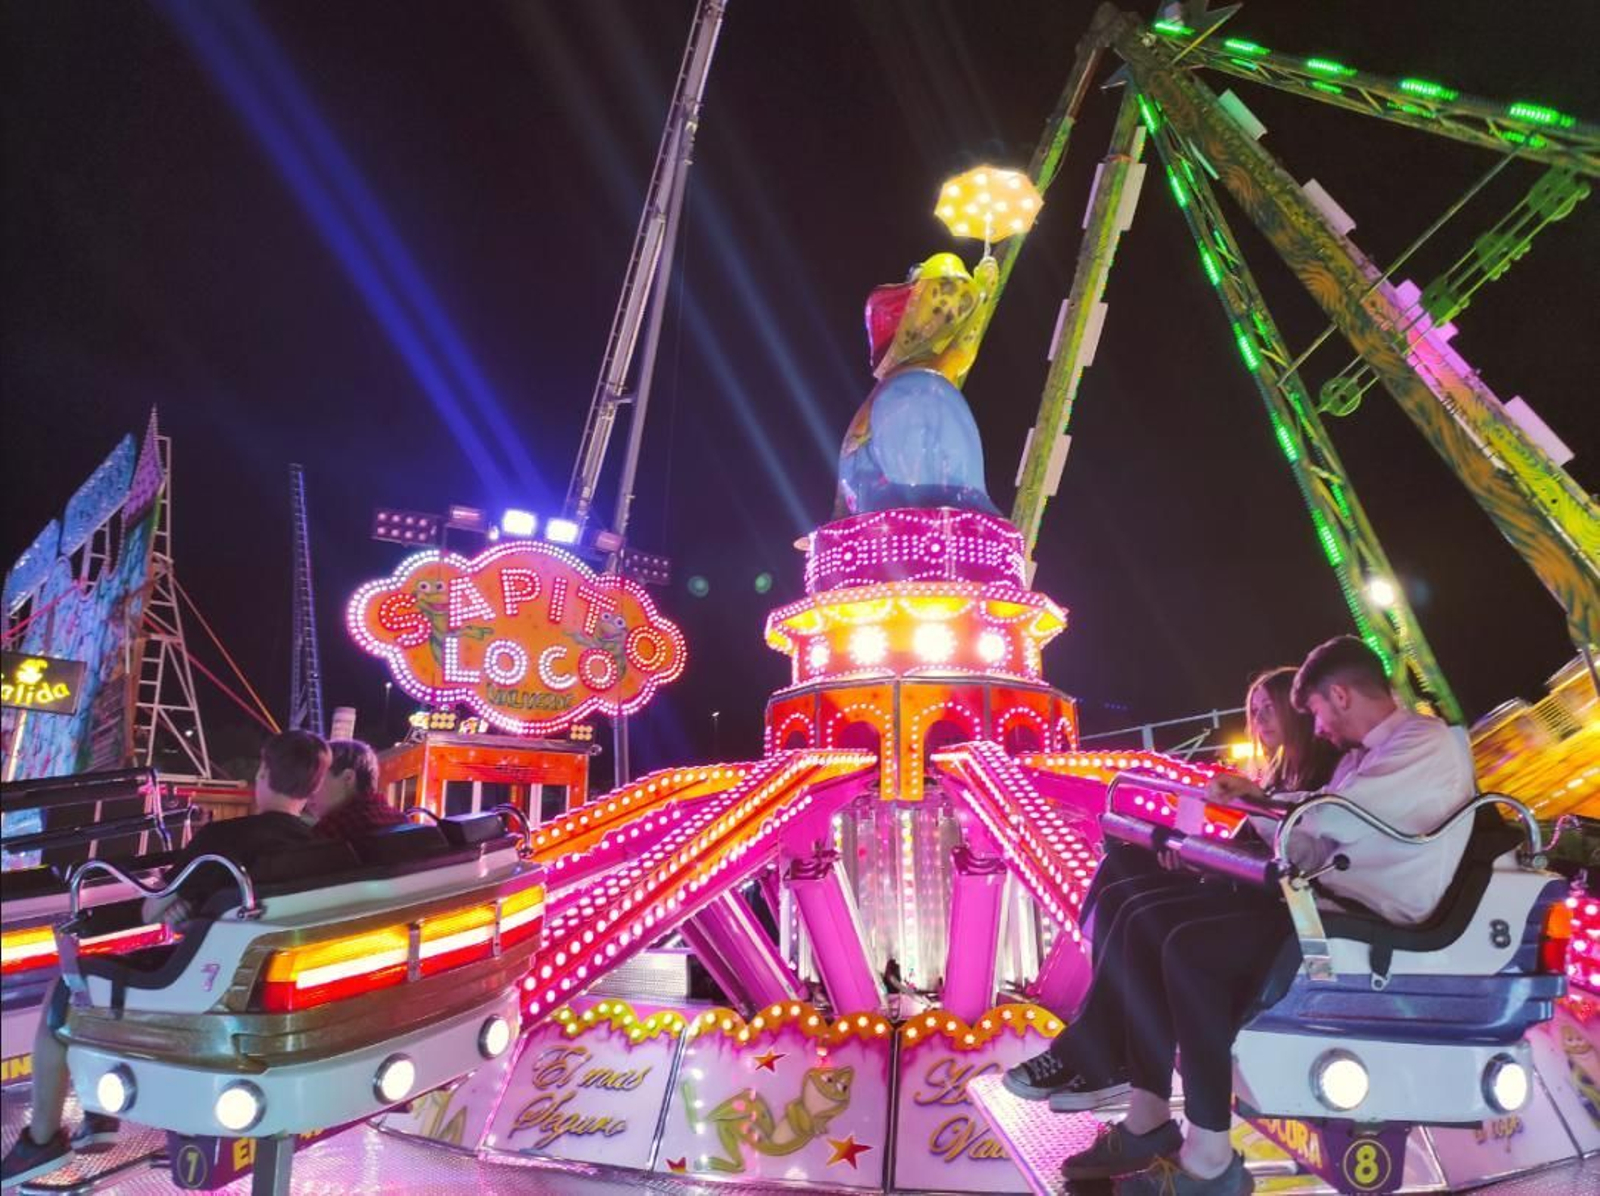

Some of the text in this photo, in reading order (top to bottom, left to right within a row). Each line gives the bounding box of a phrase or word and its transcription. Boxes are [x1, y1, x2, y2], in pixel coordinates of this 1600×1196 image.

[379, 567, 667, 671] SAPITO
[444, 636, 619, 691] LOCO
[1, 682, 71, 706] alida
[1488, 918, 1512, 949] 8
[202, 963, 220, 992] 7
[1353, 1145, 1380, 1185] 8
